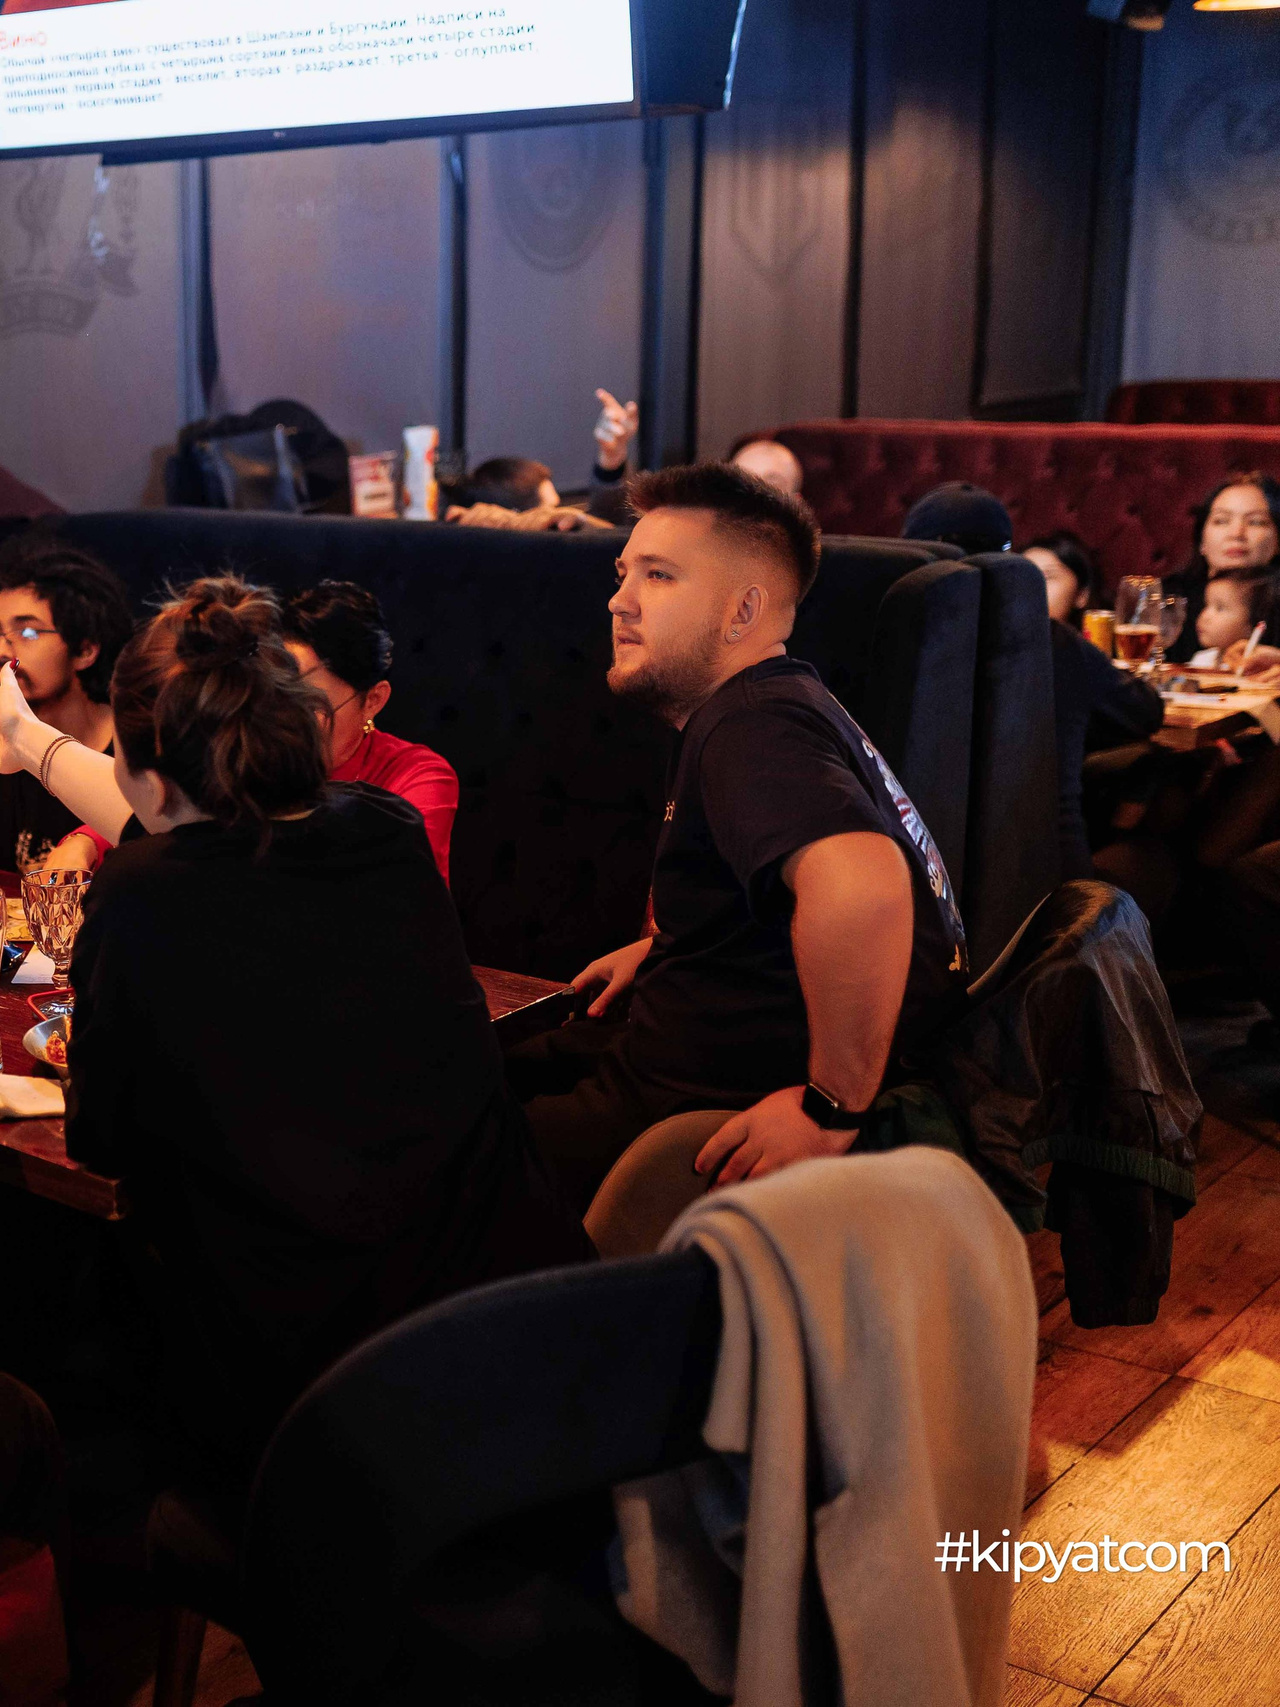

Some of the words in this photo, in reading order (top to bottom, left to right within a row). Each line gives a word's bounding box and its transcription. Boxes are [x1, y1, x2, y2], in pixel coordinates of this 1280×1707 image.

[416, 9, 484, 26] Надписи
[488, 7, 506, 18] на
[229, 49, 286, 62] сортами
[291, 45, 324, 55] вина
[328, 36, 414, 53] обозначали
[419, 29, 475, 43] четыре
[480, 22, 536, 39] стадии
[389, 50, 439, 67] третья
